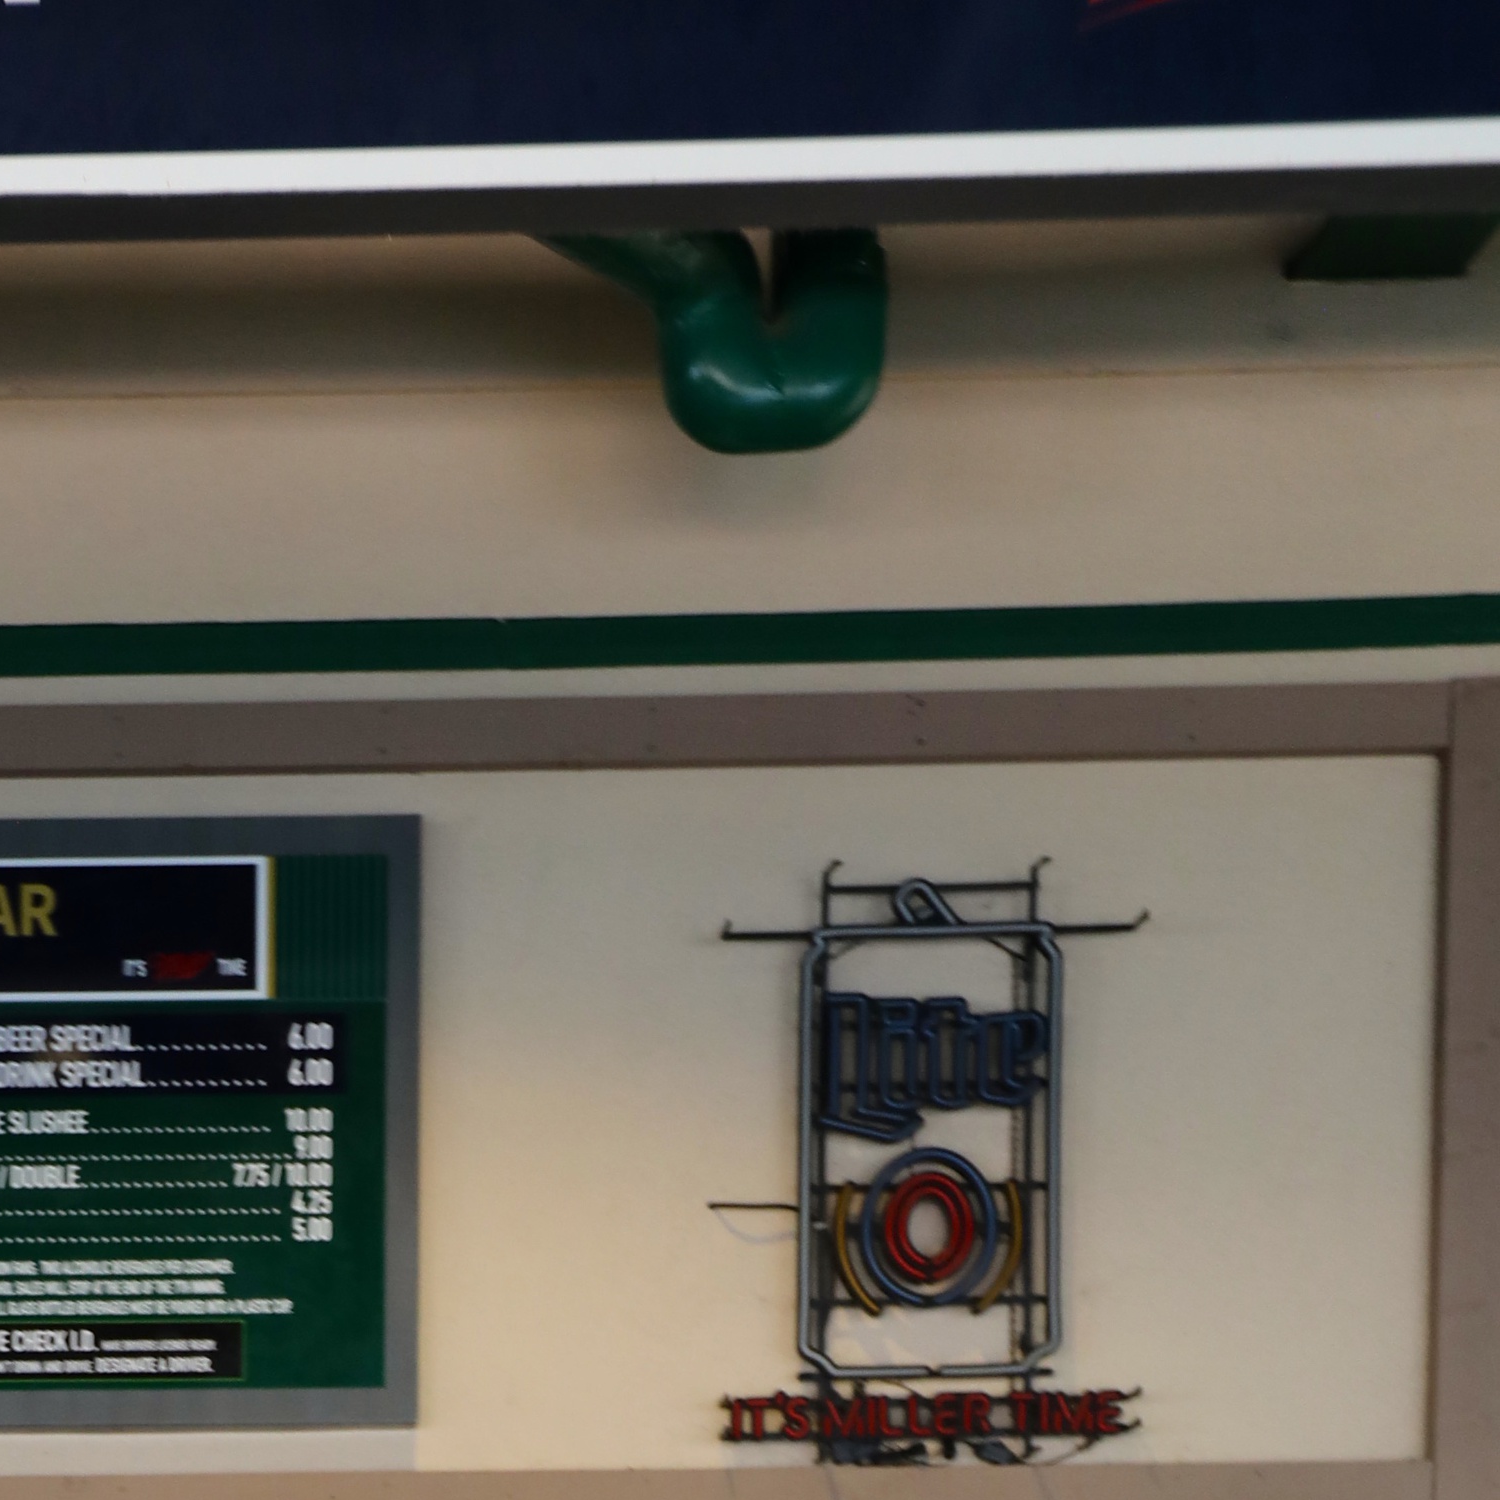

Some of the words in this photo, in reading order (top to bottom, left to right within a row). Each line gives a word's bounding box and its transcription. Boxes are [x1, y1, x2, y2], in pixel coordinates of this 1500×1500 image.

[49, 1025, 134, 1052] SPECIAL
[287, 1022, 334, 1050] 6.00
[59, 1060, 145, 1087] SPECIAL
[287, 1058, 334, 1086] 6.00
[822, 992, 1048, 1142] Lite
[284, 1107, 334, 1132] 10.00
[293, 1134, 334, 1160] 9.00
[232, 1162, 270, 1187] 7.75
[284, 1162, 334, 1187] 10.00
[290, 1188, 333, 1214] 4.25
[291, 1216, 334, 1242] 5.00
[11, 1330, 69, 1352] CHECK
[730, 1391, 811, 1440] IT'S
[823, 1392, 991, 1438] MILLER
[1009, 1390, 1122, 1435] TIME
